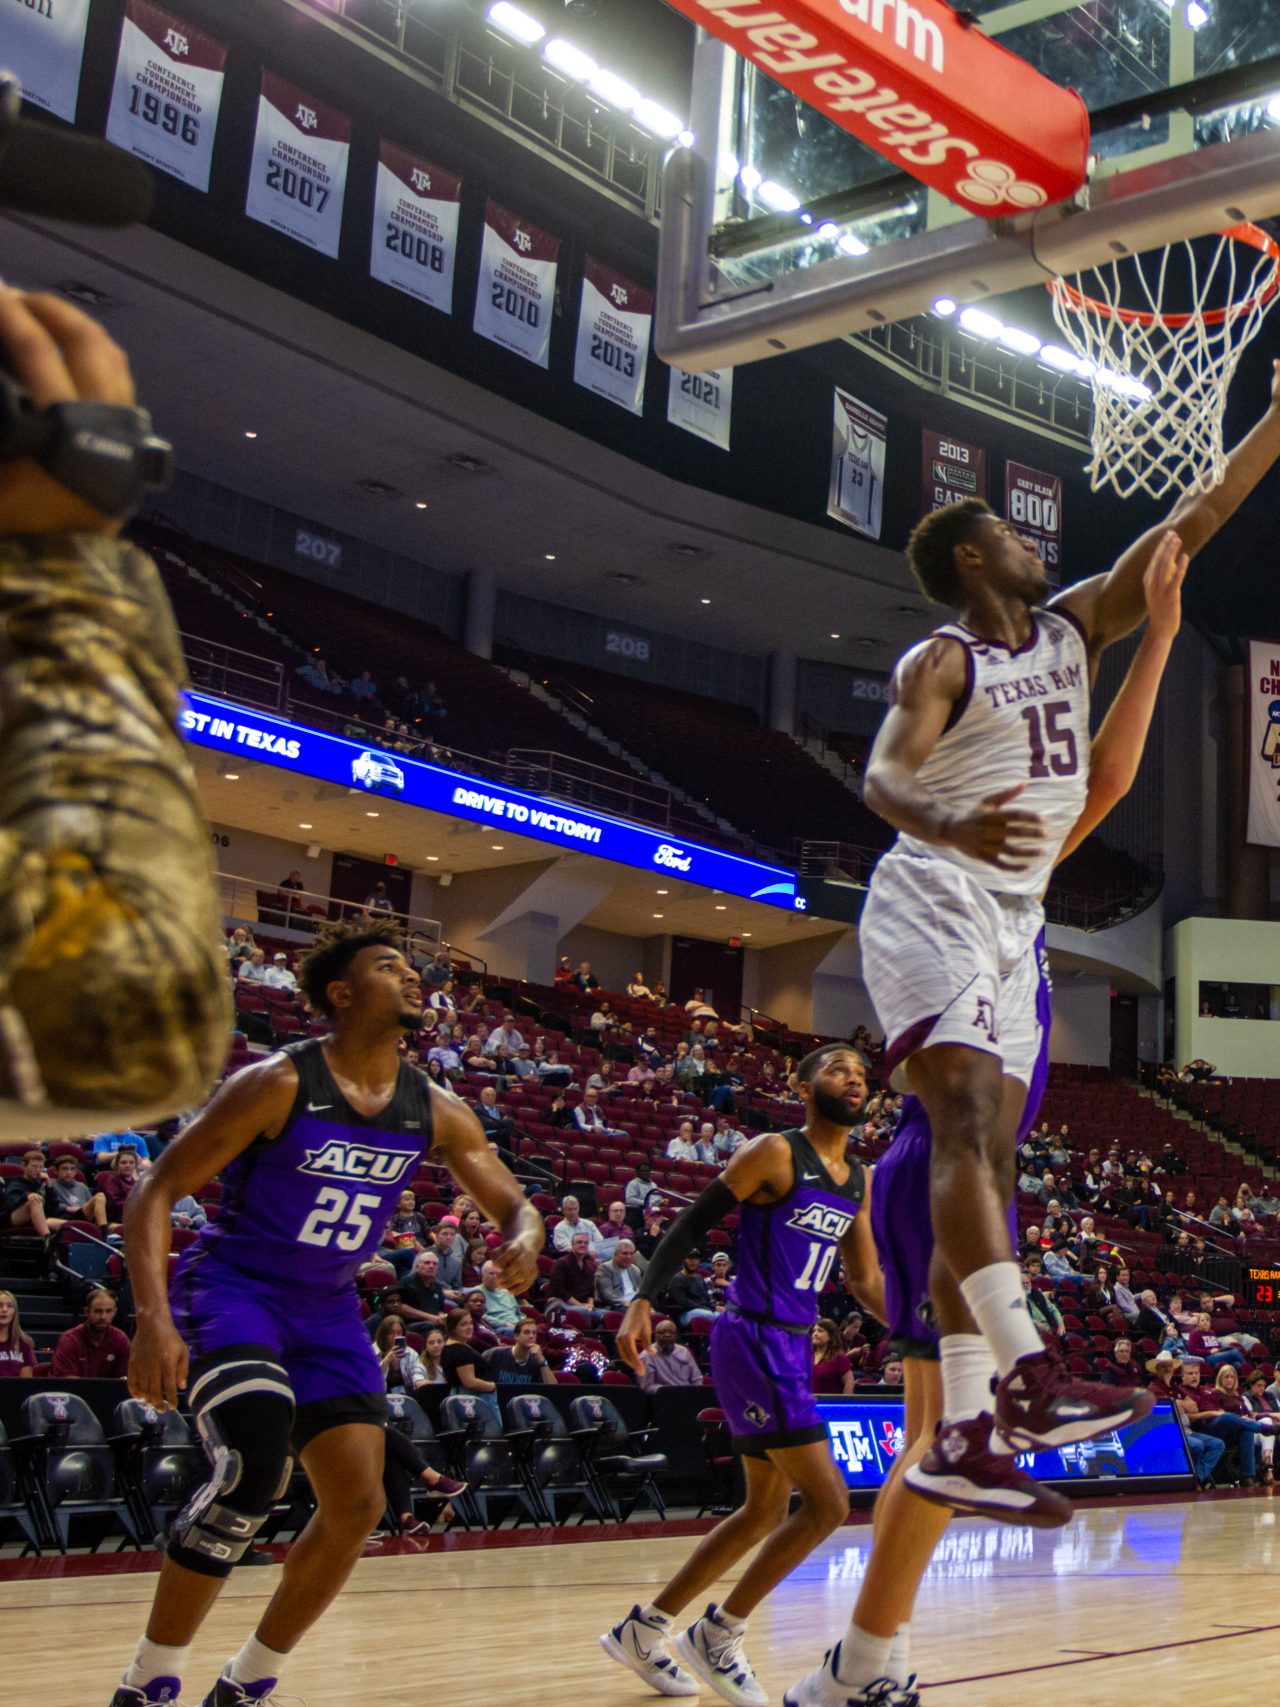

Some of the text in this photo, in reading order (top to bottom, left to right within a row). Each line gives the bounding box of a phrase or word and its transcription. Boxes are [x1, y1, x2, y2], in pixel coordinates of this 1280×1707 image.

[144, 67, 197, 101] TOURNAMENT
[147, 60, 196, 92] CONFERENCE
[136, 72, 202, 114] CHAMPIONSHIP
[129, 85, 201, 146] 1996
[813, 67, 979, 165] State
[271, 148, 331, 184] CHAMPIONSHIP
[277, 140, 327, 173] CONFERENCE
[266, 160, 331, 215] 2007
[390, 211, 444, 243] CHAMPIONSHIP
[396, 206, 439, 232] TOURNAMENT
[398, 198, 438, 224] CONFERENCE
[386, 223, 445, 274] 2008
[494, 270, 542, 300] CHAMPIONSHIP
[500, 264, 538, 289] TOURNAMENT
[502, 257, 538, 281] CONFERENCE
[491, 281, 539, 328] 2010
[594, 322, 638, 351] CHAMPIONSHIP
[598, 317, 634, 342] TOURNAMENT
[600, 311, 633, 333] CONFERENCE
[590, 334, 635, 378] 2013
[681, 372, 721, 409] 2021
[939, 441, 969, 463] 2013
[852, 469, 863, 487] 23
[1011, 488, 1057, 532] 800
[295, 533, 341, 564] 207
[606, 633, 649, 660] 208
[984, 675, 1048, 708] TEXAS
[210, 718, 235, 740] IN
[235, 726, 301, 759] TEXAS
[1021, 701, 1078, 778] 15
[453, 787, 602, 843] DRIVE TO VICTORY!
[653, 843, 691, 873] Ford
[310, 1147, 406, 1178] ACU
[297, 1186, 382, 1251] 25
[797, 1207, 853, 1238] ACU
[793, 1242, 838, 1293] 10
[1249, 1269, 1269, 1280] TEXAS
[1256, 1285, 1273, 1303] 23
